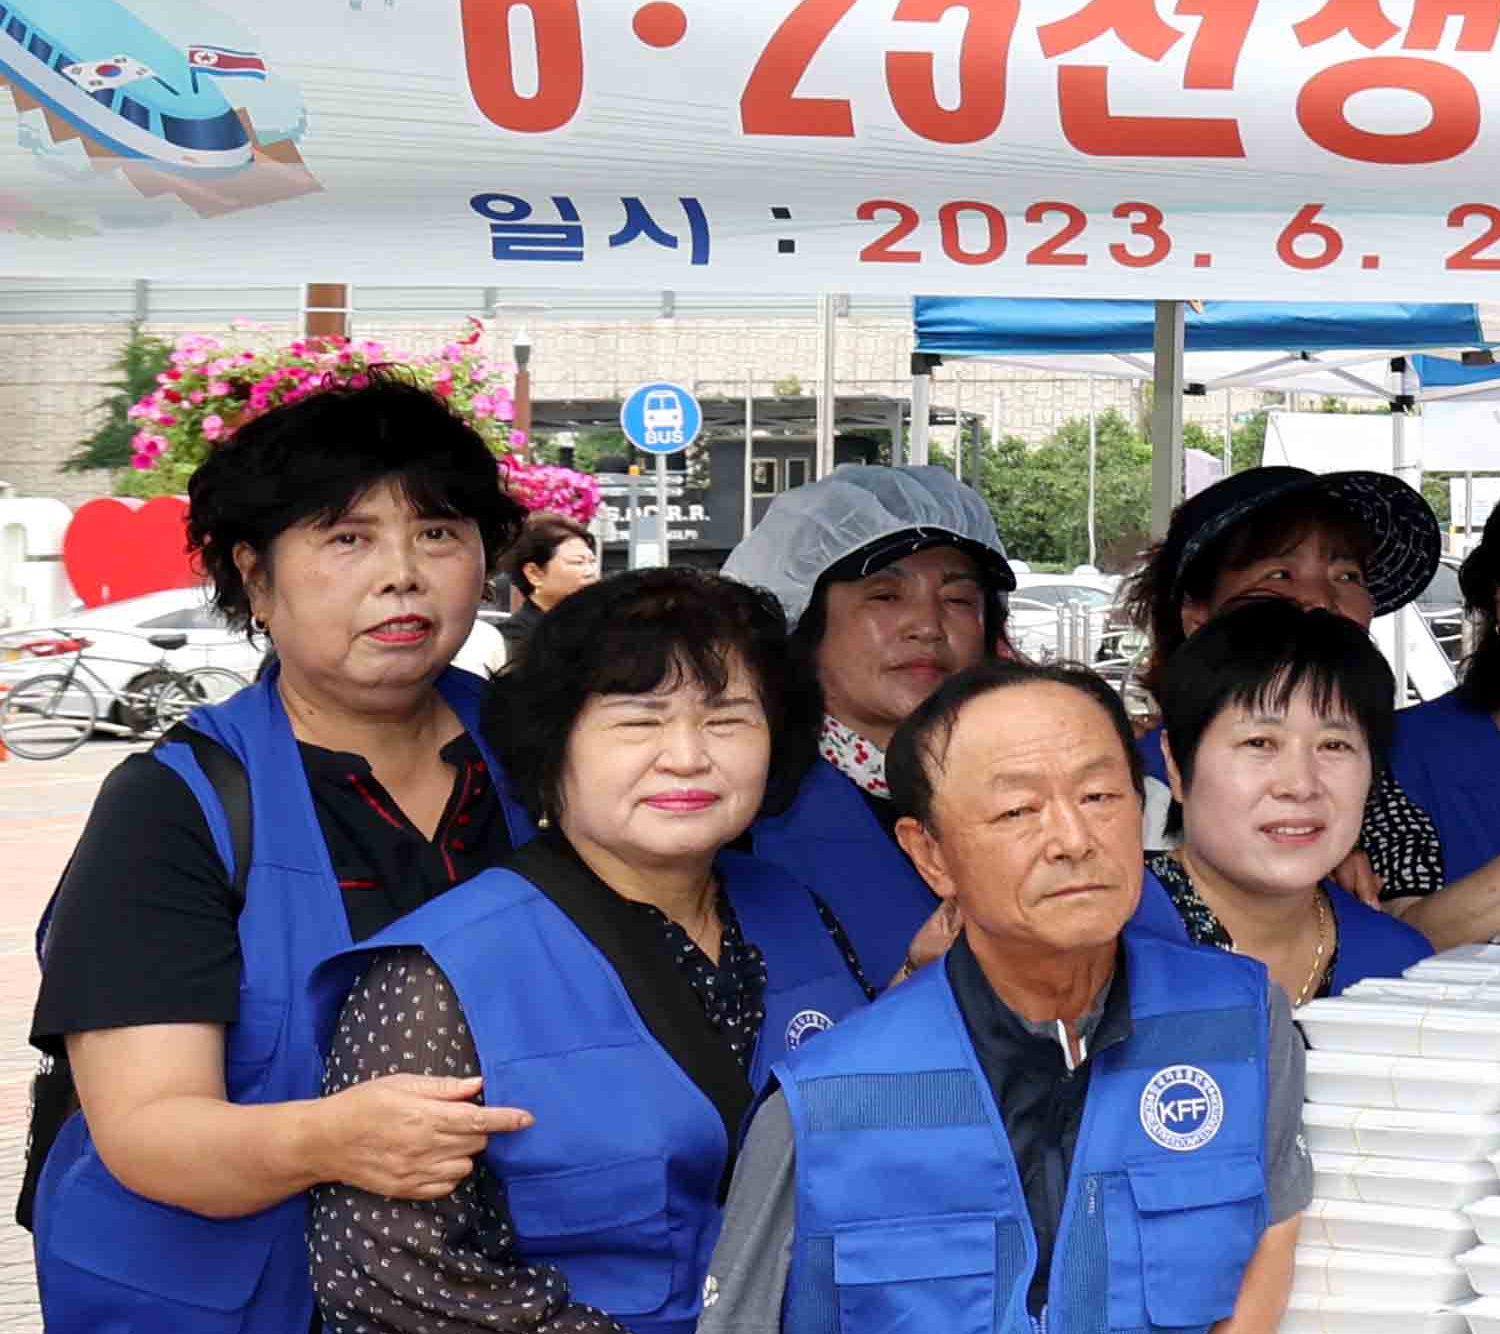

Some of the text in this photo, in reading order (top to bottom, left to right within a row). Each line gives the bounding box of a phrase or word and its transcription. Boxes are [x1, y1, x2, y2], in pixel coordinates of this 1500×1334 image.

[469, 192, 711, 267] 일시
[858, 198, 1211, 269] 2023.
[1277, 202, 1380, 270] 6.
[644, 429, 685, 446] BUS
[1158, 1097, 1207, 1124] KFF
